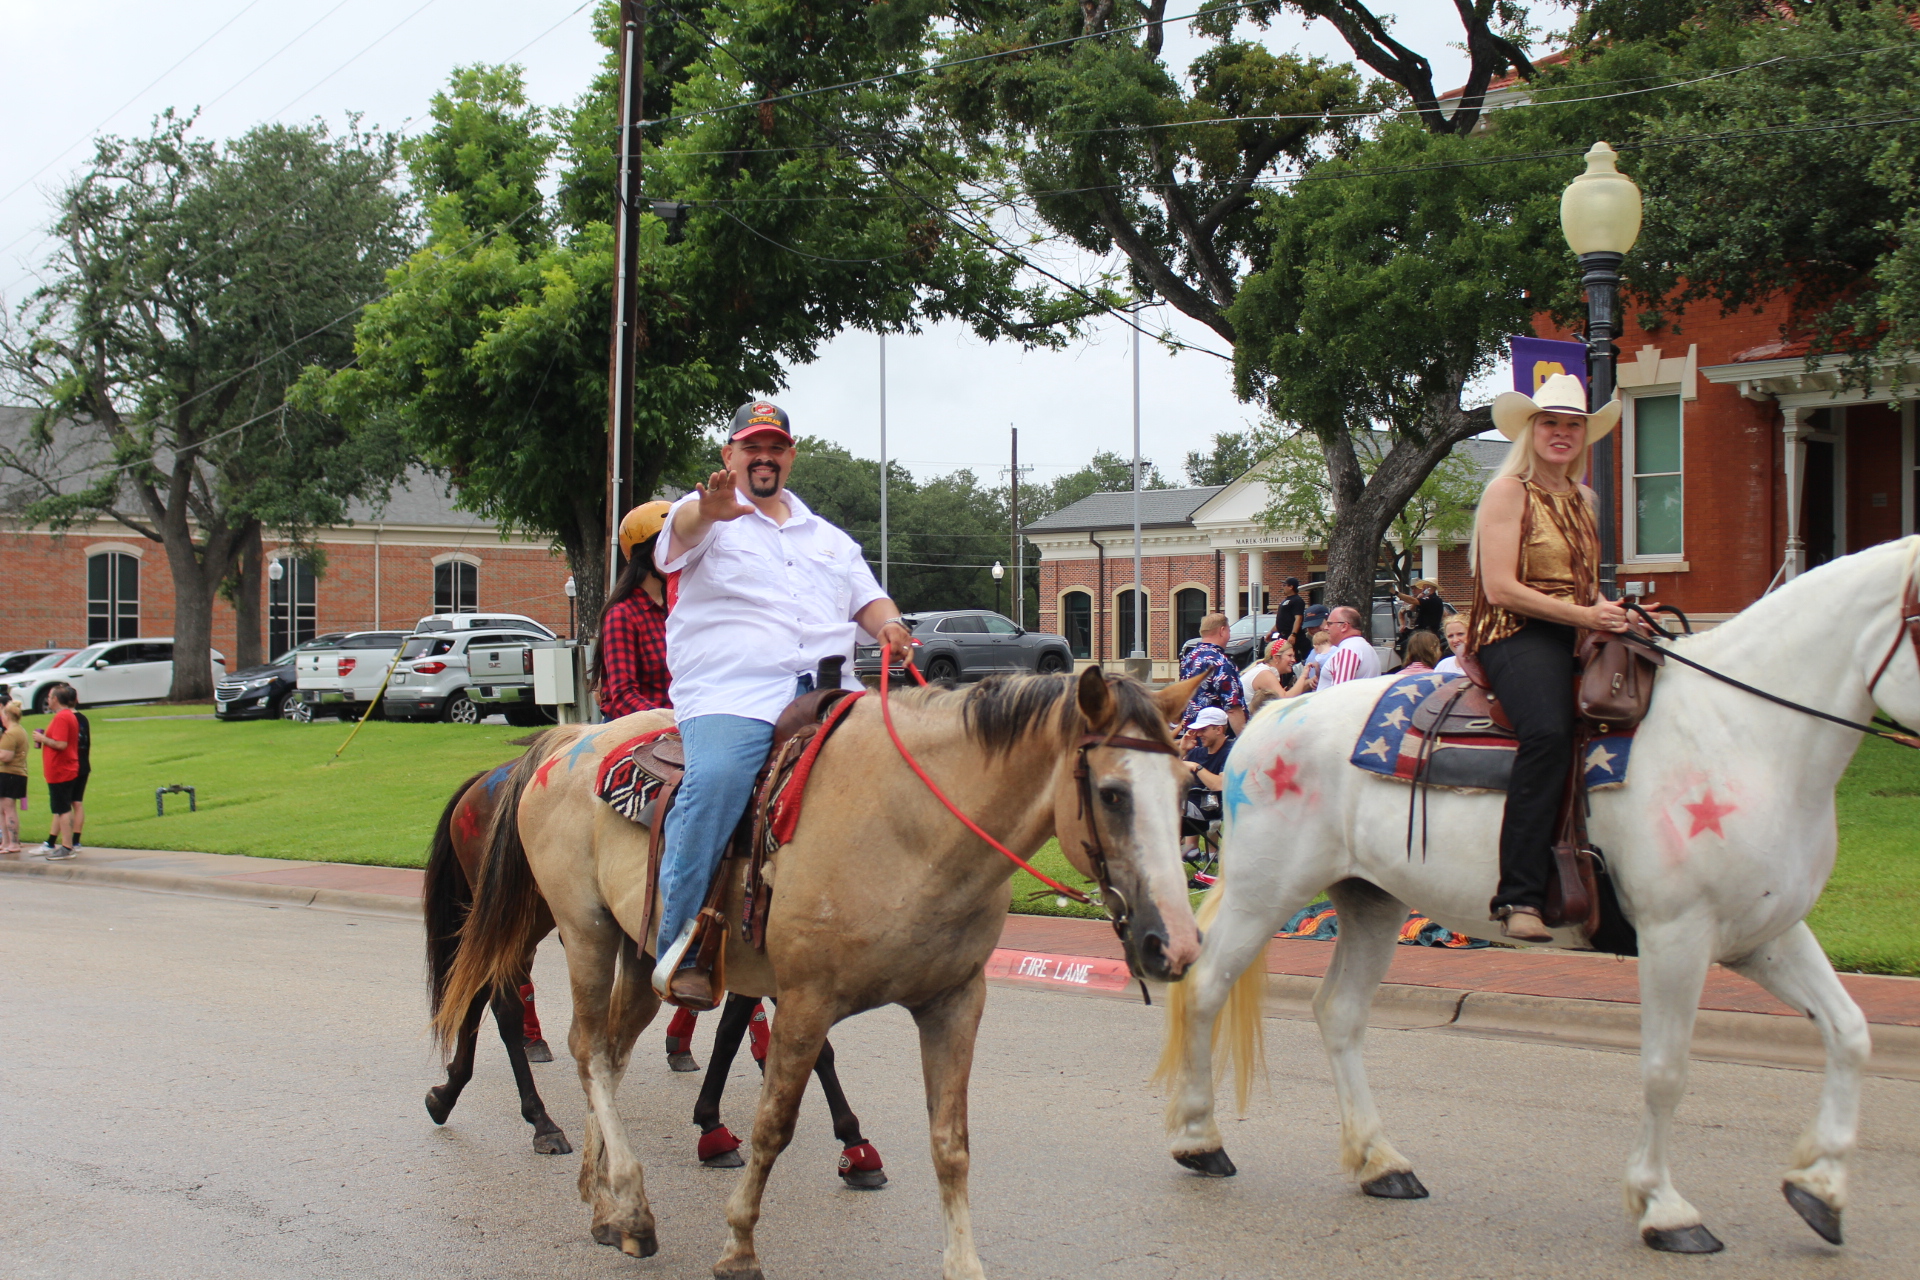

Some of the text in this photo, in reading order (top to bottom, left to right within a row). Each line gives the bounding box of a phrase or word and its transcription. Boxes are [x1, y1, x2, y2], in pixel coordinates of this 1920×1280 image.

[748, 416, 782, 426] VETERAN
[1235, 536, 1279, 545] MAREK-SMITH
[1281, 535, 1305, 543] CENTER
[1018, 956, 1094, 984] FIRE LANE
